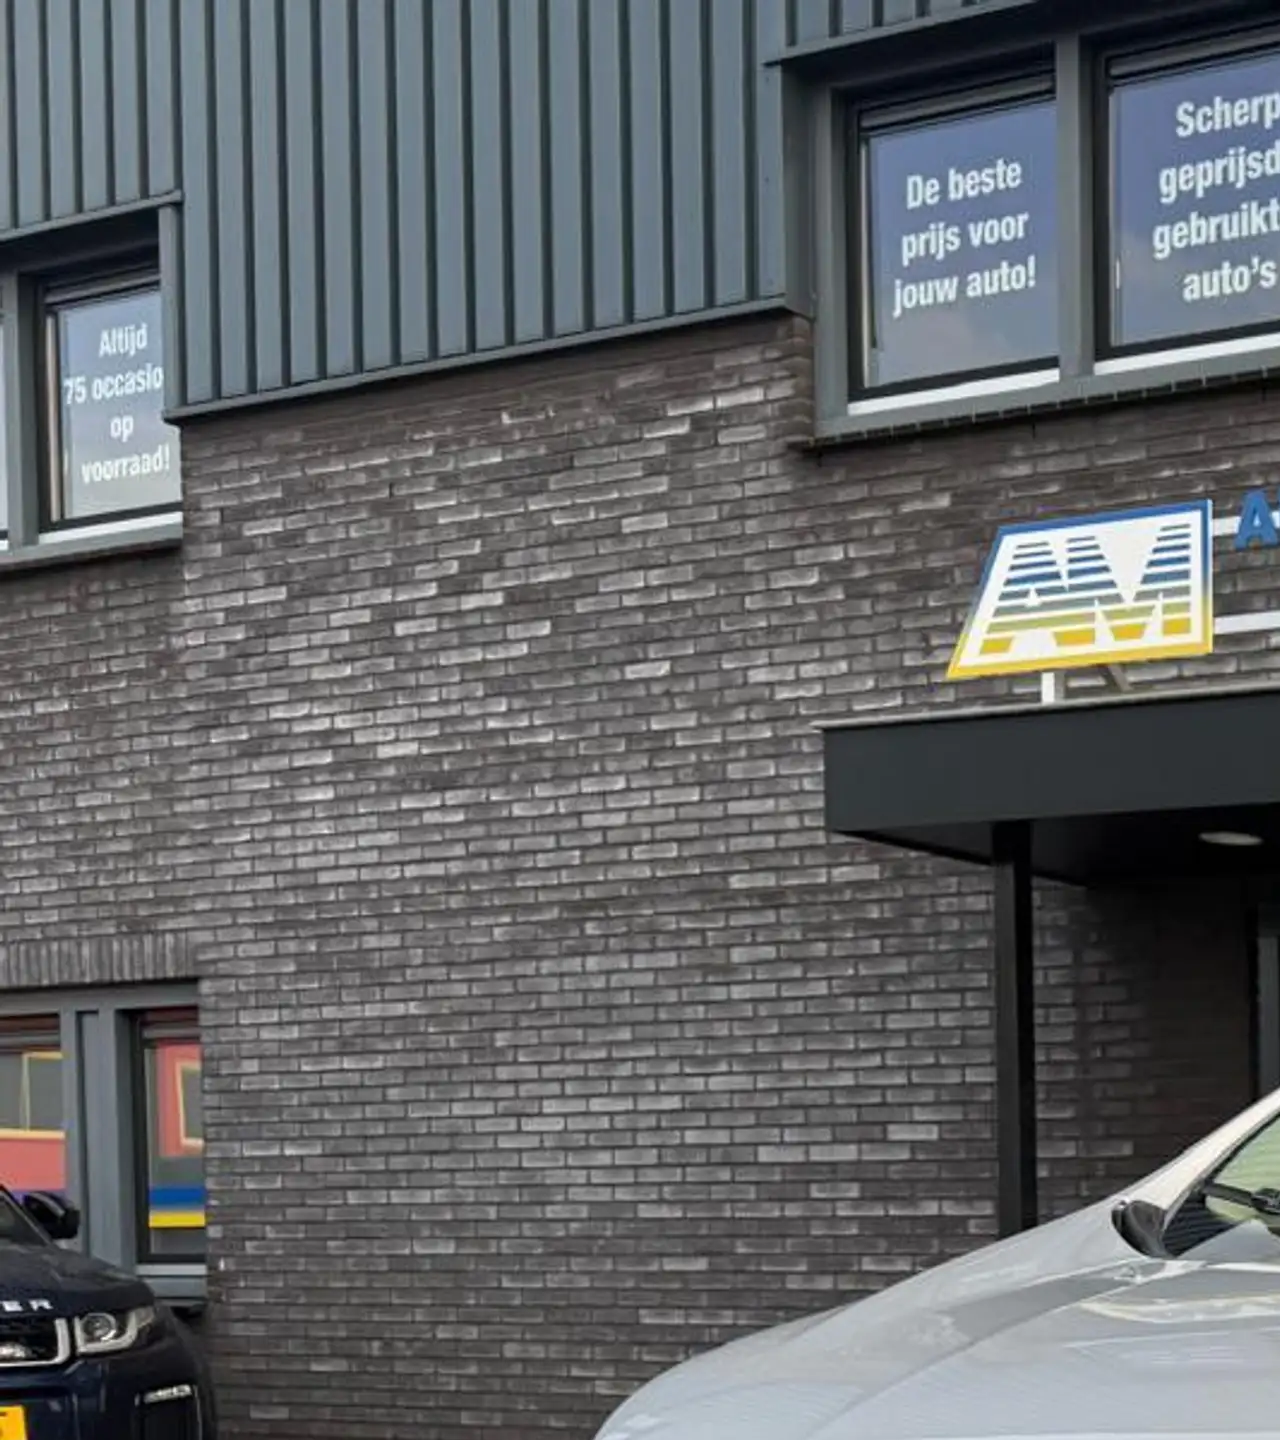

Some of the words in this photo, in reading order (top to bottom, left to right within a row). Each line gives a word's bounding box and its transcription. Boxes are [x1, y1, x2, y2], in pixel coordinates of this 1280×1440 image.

[907, 174, 941, 210] De
[948, 158, 1022, 201] beste
[902, 221, 962, 267] prijs
[968, 211, 1030, 248] voor
[893, 276, 959, 320] jouw
[966, 253, 1036, 298] auto!
[1183, 255, 1278, 302] auto's
[99, 322, 148, 357] Altijd
[64, 375, 86, 404] 75
[110, 415, 134, 442] op
[81, 443, 171, 484] voorraad!
[978, 523, 1192, 656] AM
